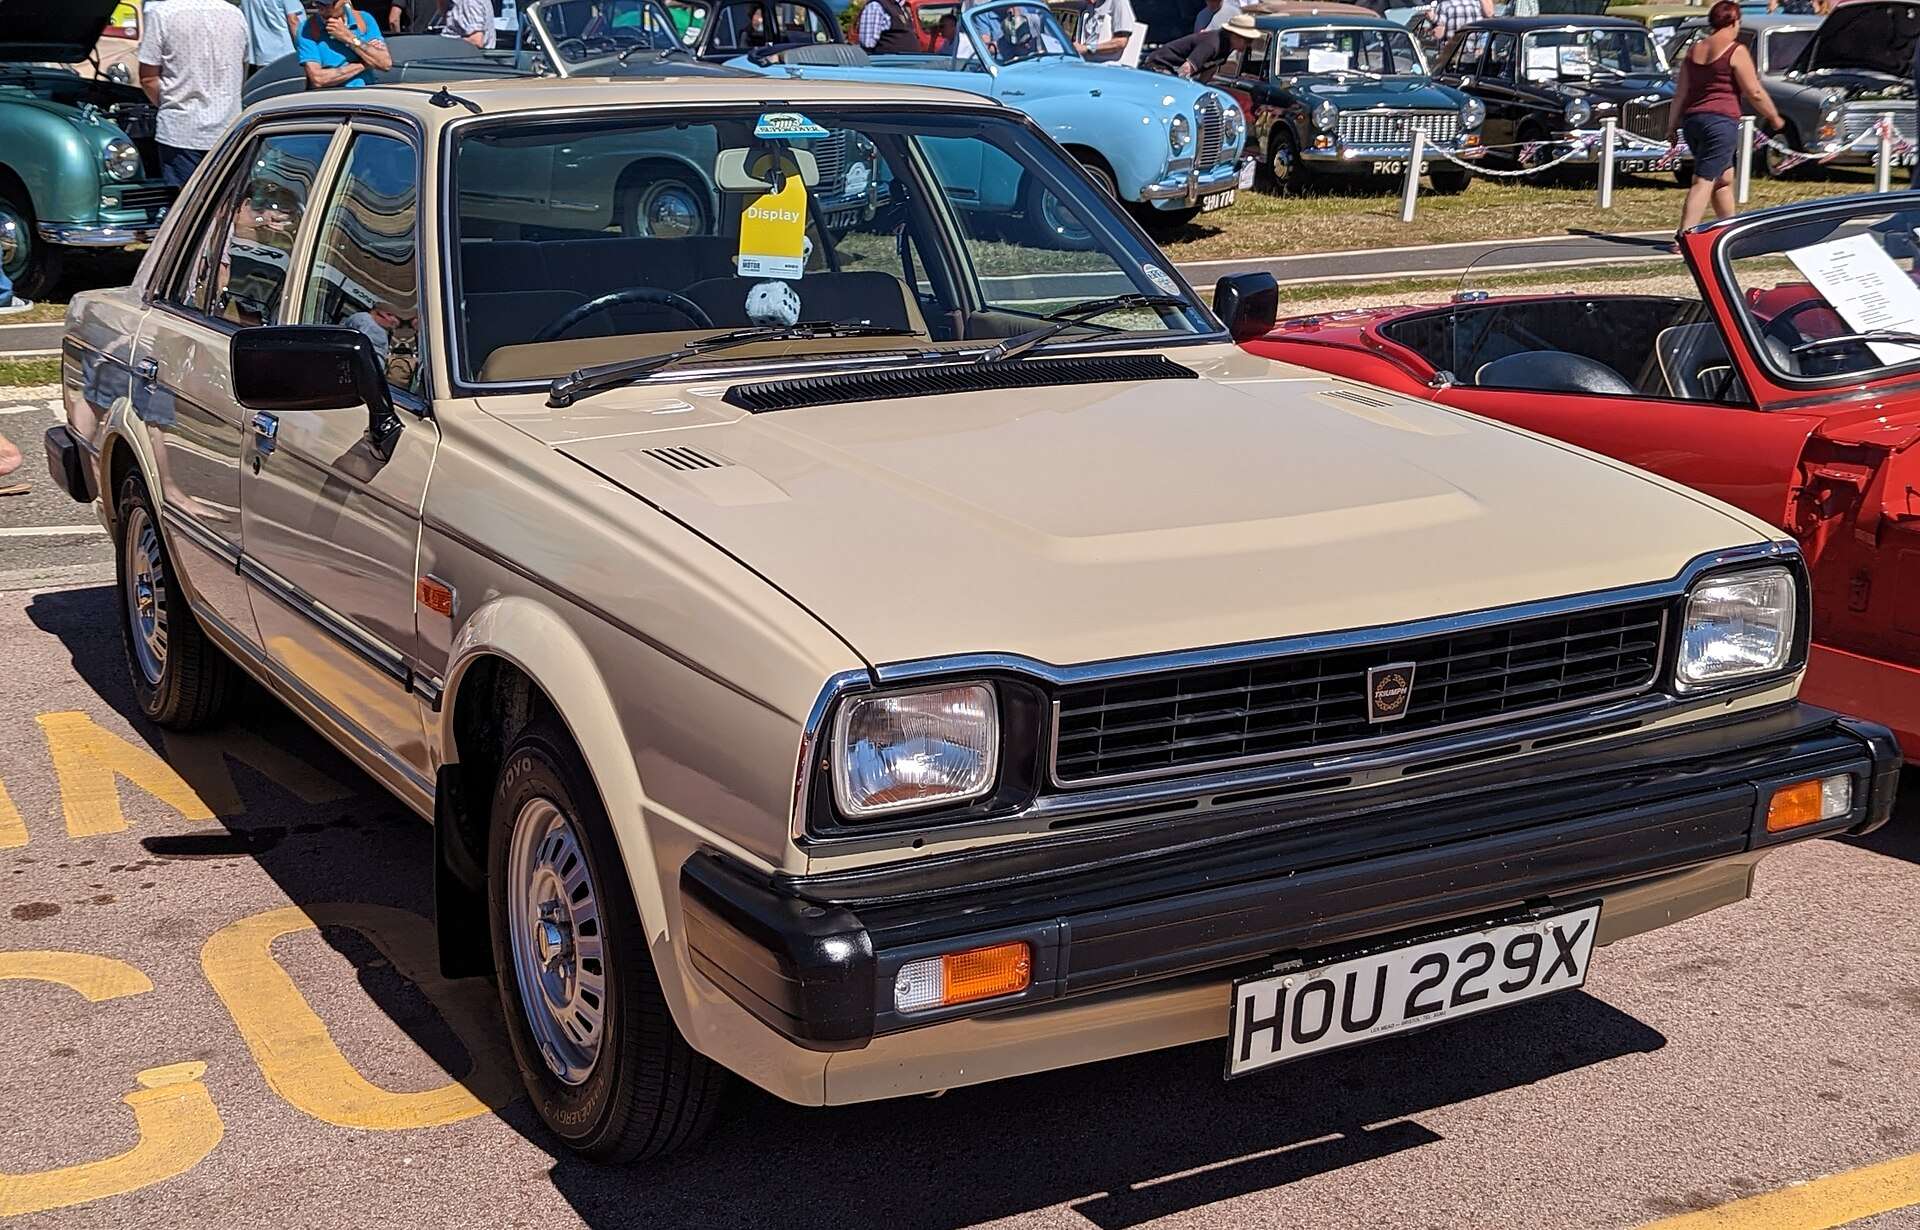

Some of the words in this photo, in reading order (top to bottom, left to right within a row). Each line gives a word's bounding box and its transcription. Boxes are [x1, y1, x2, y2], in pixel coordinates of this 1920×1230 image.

[1373, 161, 1400, 174] PKG
[1620, 159, 1645, 172] UFD
[1220, 190, 1234, 207] 774
[747, 207, 800, 224] Display
[1375, 687, 1408, 698] TRIUMPH
[500, 757, 531, 799] TOYO
[1240, 964, 1389, 1063] HOU
[1403, 918, 1591, 1020] 229X
